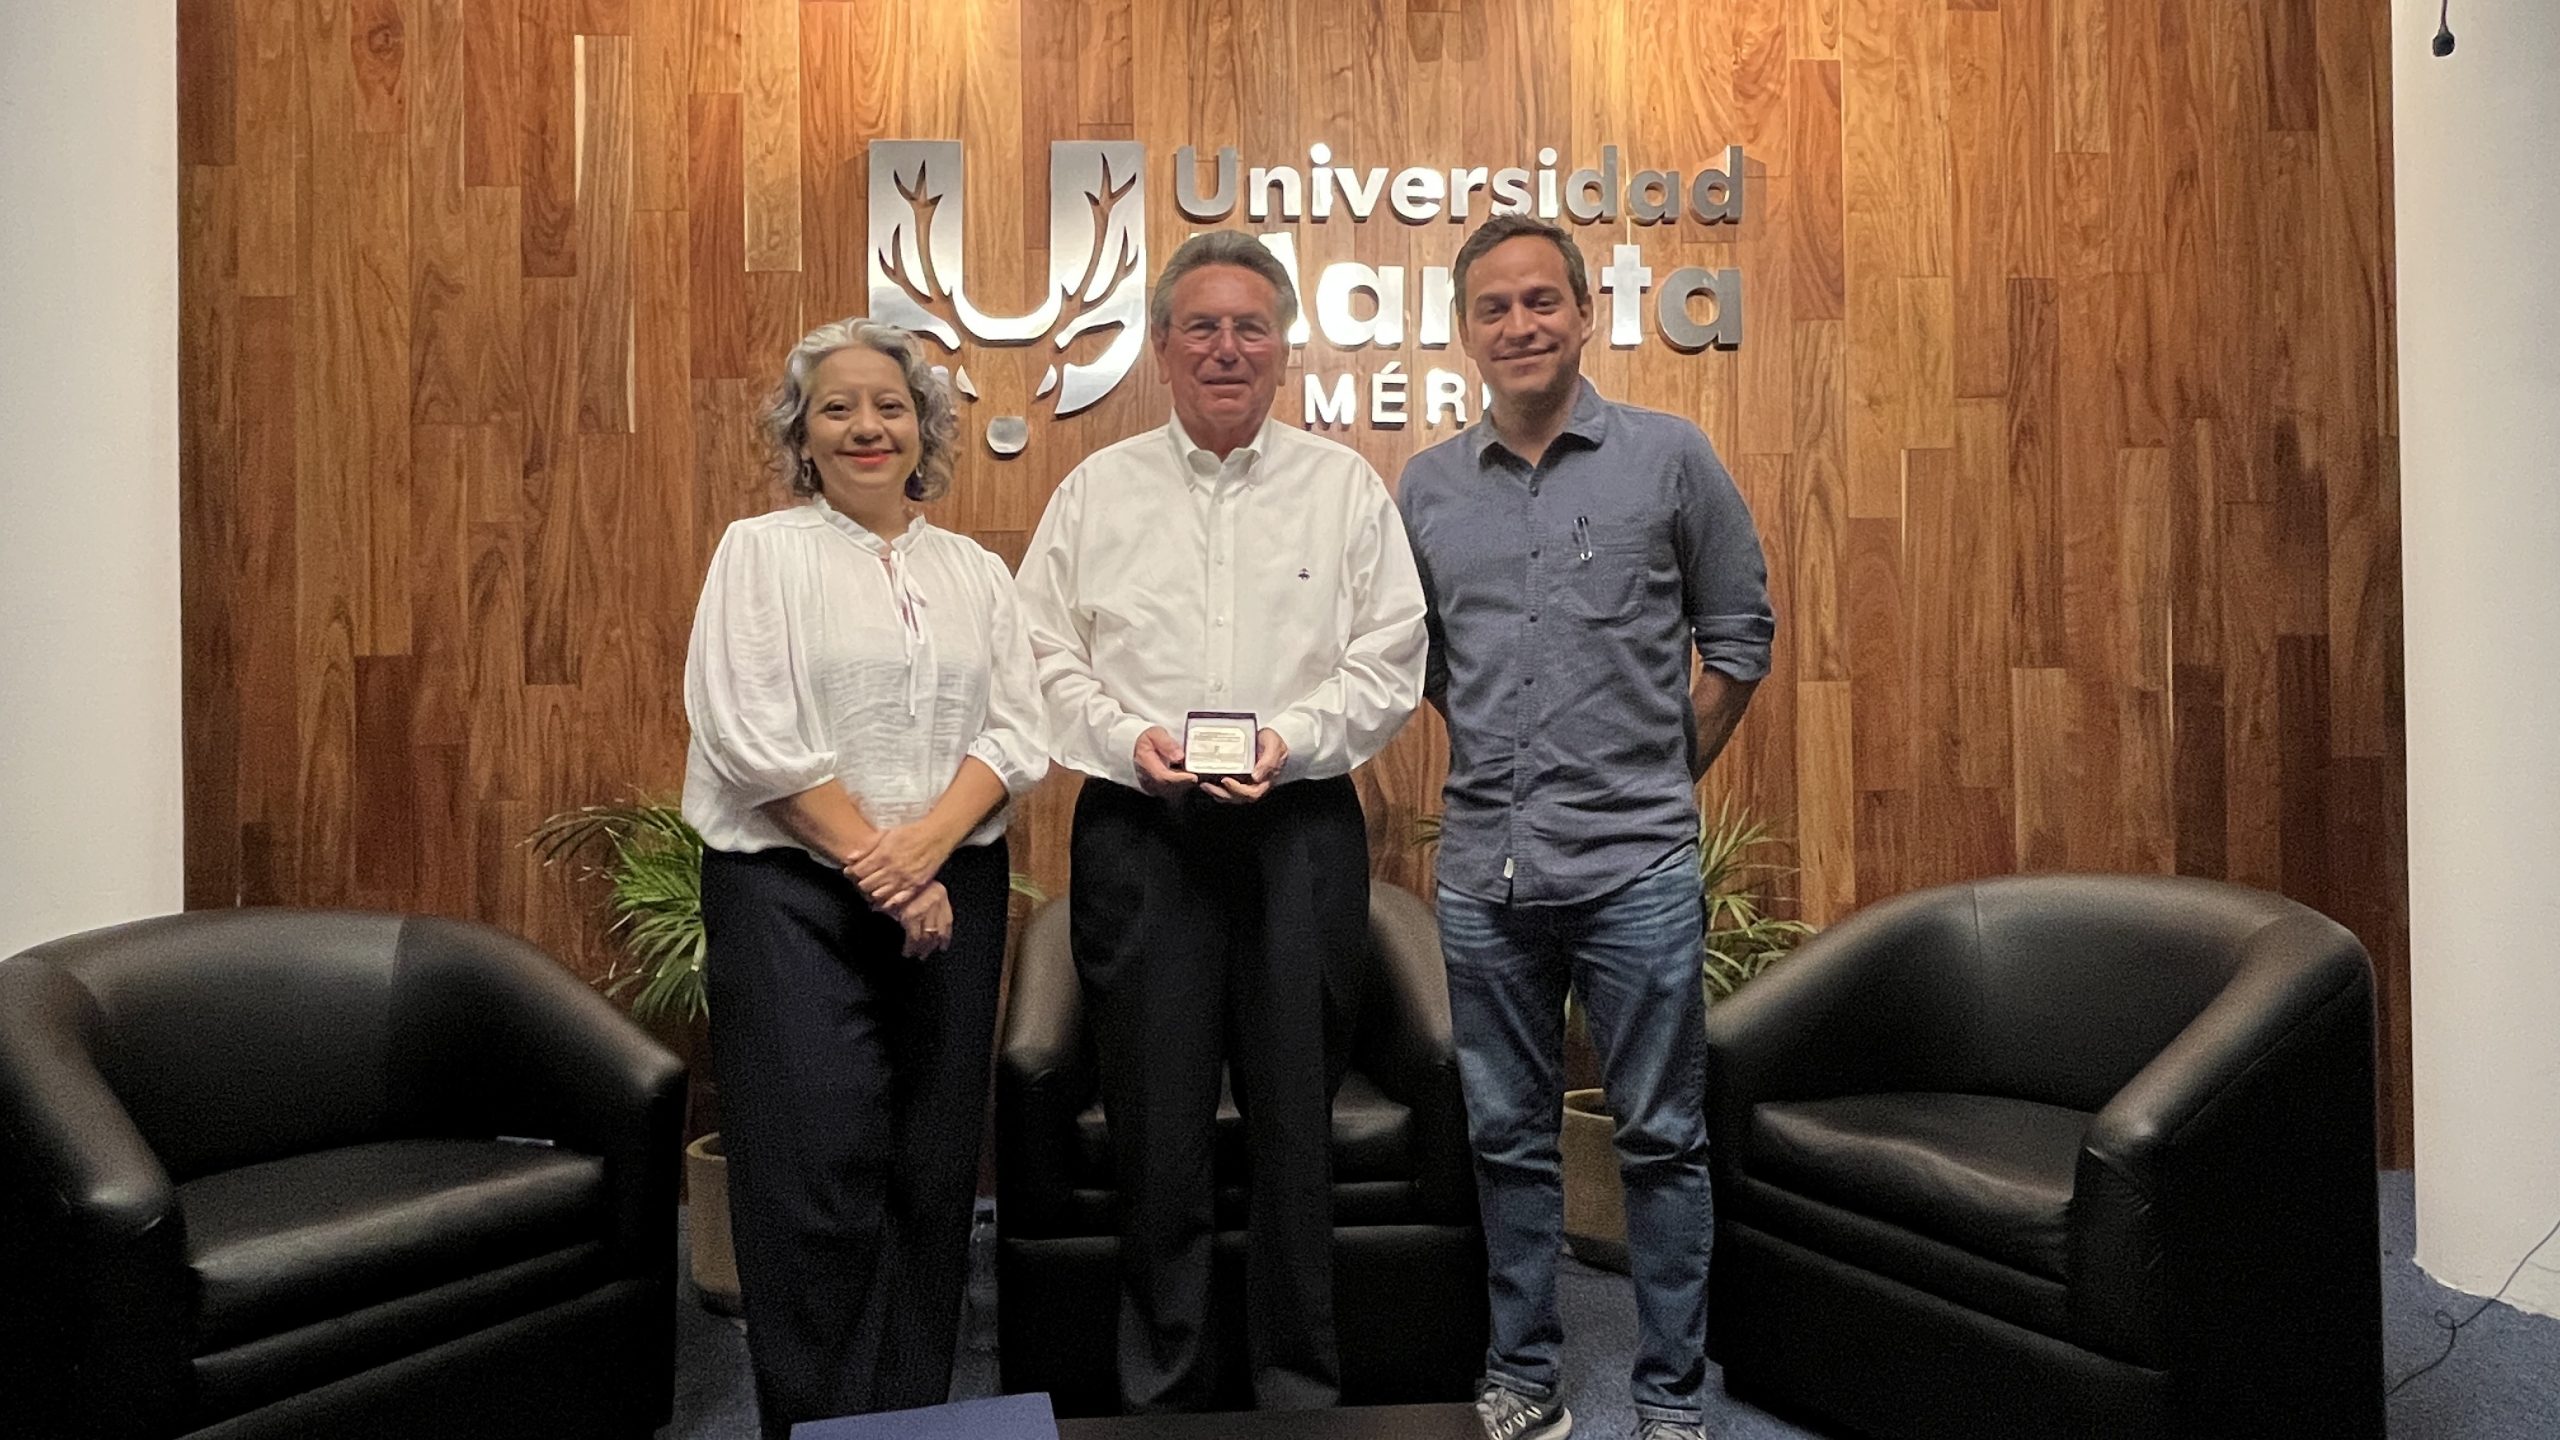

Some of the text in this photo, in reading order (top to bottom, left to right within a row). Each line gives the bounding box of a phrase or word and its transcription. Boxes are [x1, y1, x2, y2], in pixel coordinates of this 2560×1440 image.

[1175, 142, 1744, 225] Universidad
[1189, 231, 1743, 351] arta
[1303, 361, 1493, 429] MÉR
